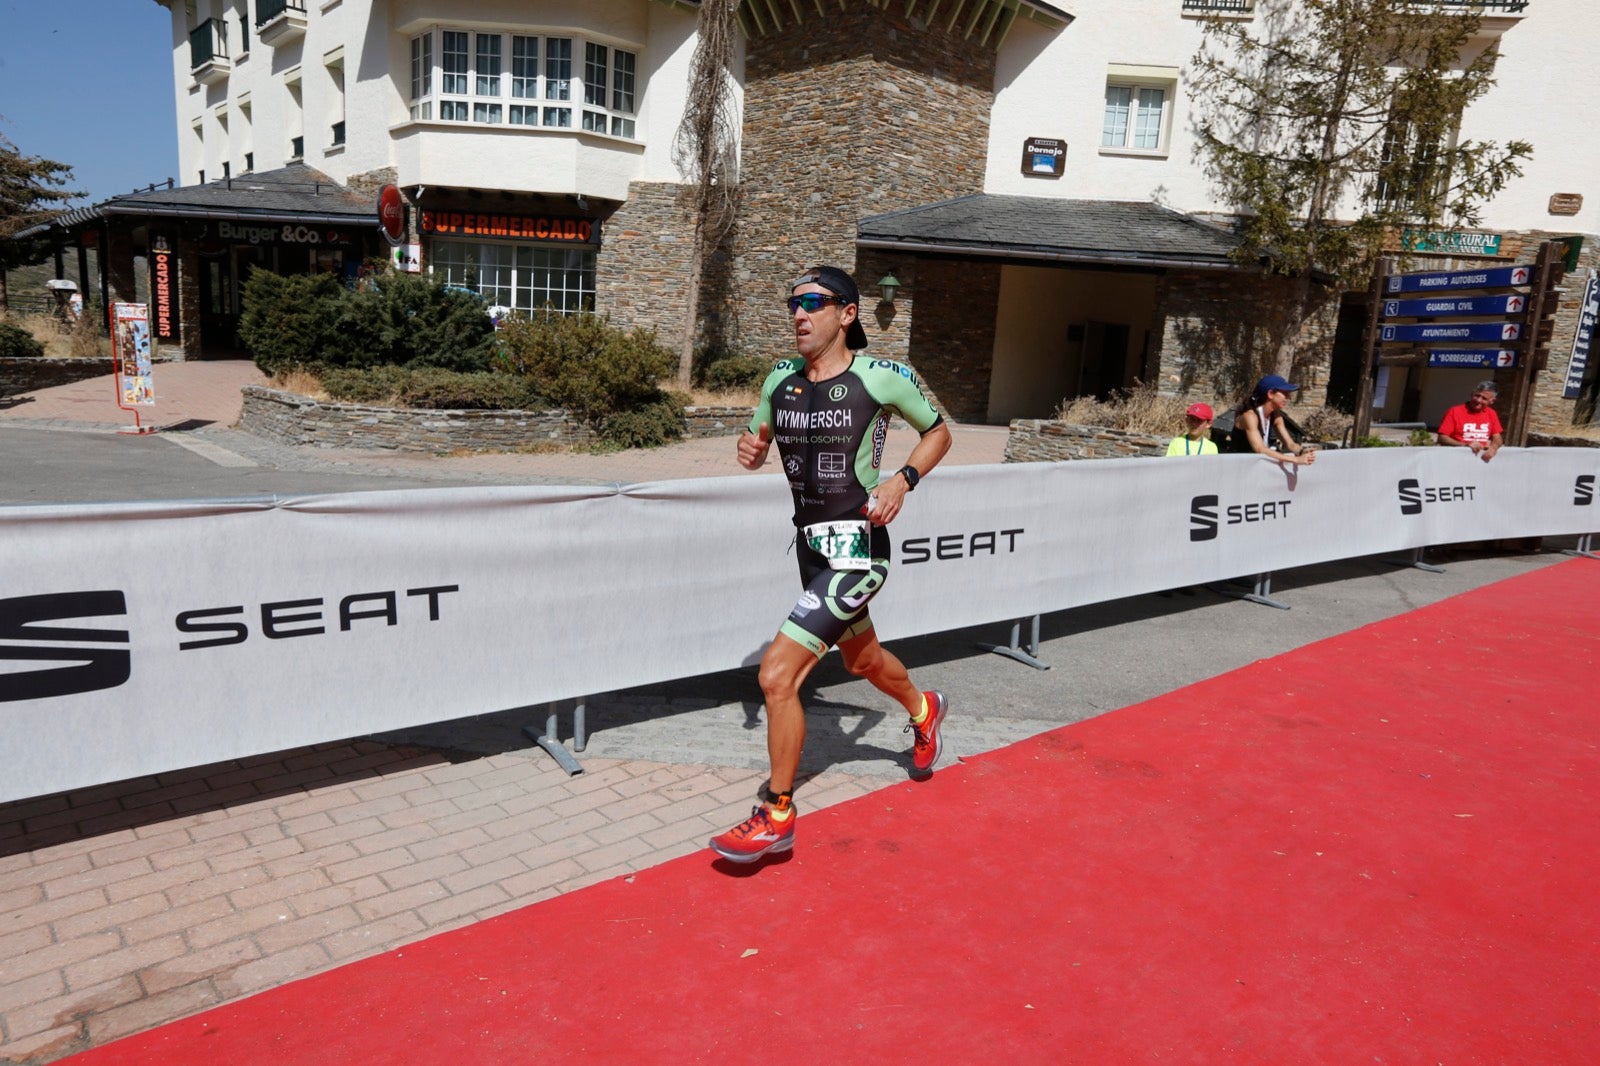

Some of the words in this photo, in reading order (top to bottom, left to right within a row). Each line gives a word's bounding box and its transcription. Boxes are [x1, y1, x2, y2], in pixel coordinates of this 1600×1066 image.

[1028, 145, 1063, 156] Dornajo
[218, 221, 278, 244] Burger
[281, 225, 322, 244] &Co.
[421, 210, 592, 241] SUPERMERCADO
[1459, 233, 1497, 247] RURAL
[1419, 277, 1448, 287] PARKING
[1450, 274, 1487, 285] AUTOBUSES
[157, 253, 171, 337] SUPERMERCADO
[1426, 302, 1455, 312] GUARDIA
[1458, 302, 1473, 311] CIVIL
[1421, 328, 1470, 337] AYUNTAMIENTO
[1429, 354, 1435, 362] A
[776, 408, 852, 429] WYMMERSCH
[1463, 422, 1489, 433] ALS
[817, 471, 847, 479] busch
[1424, 486, 1476, 503] SEAT
[1227, 500, 1291, 524] SEAT
[901, 528, 1024, 565] SEAT
[175, 584, 459, 651] SEAT
